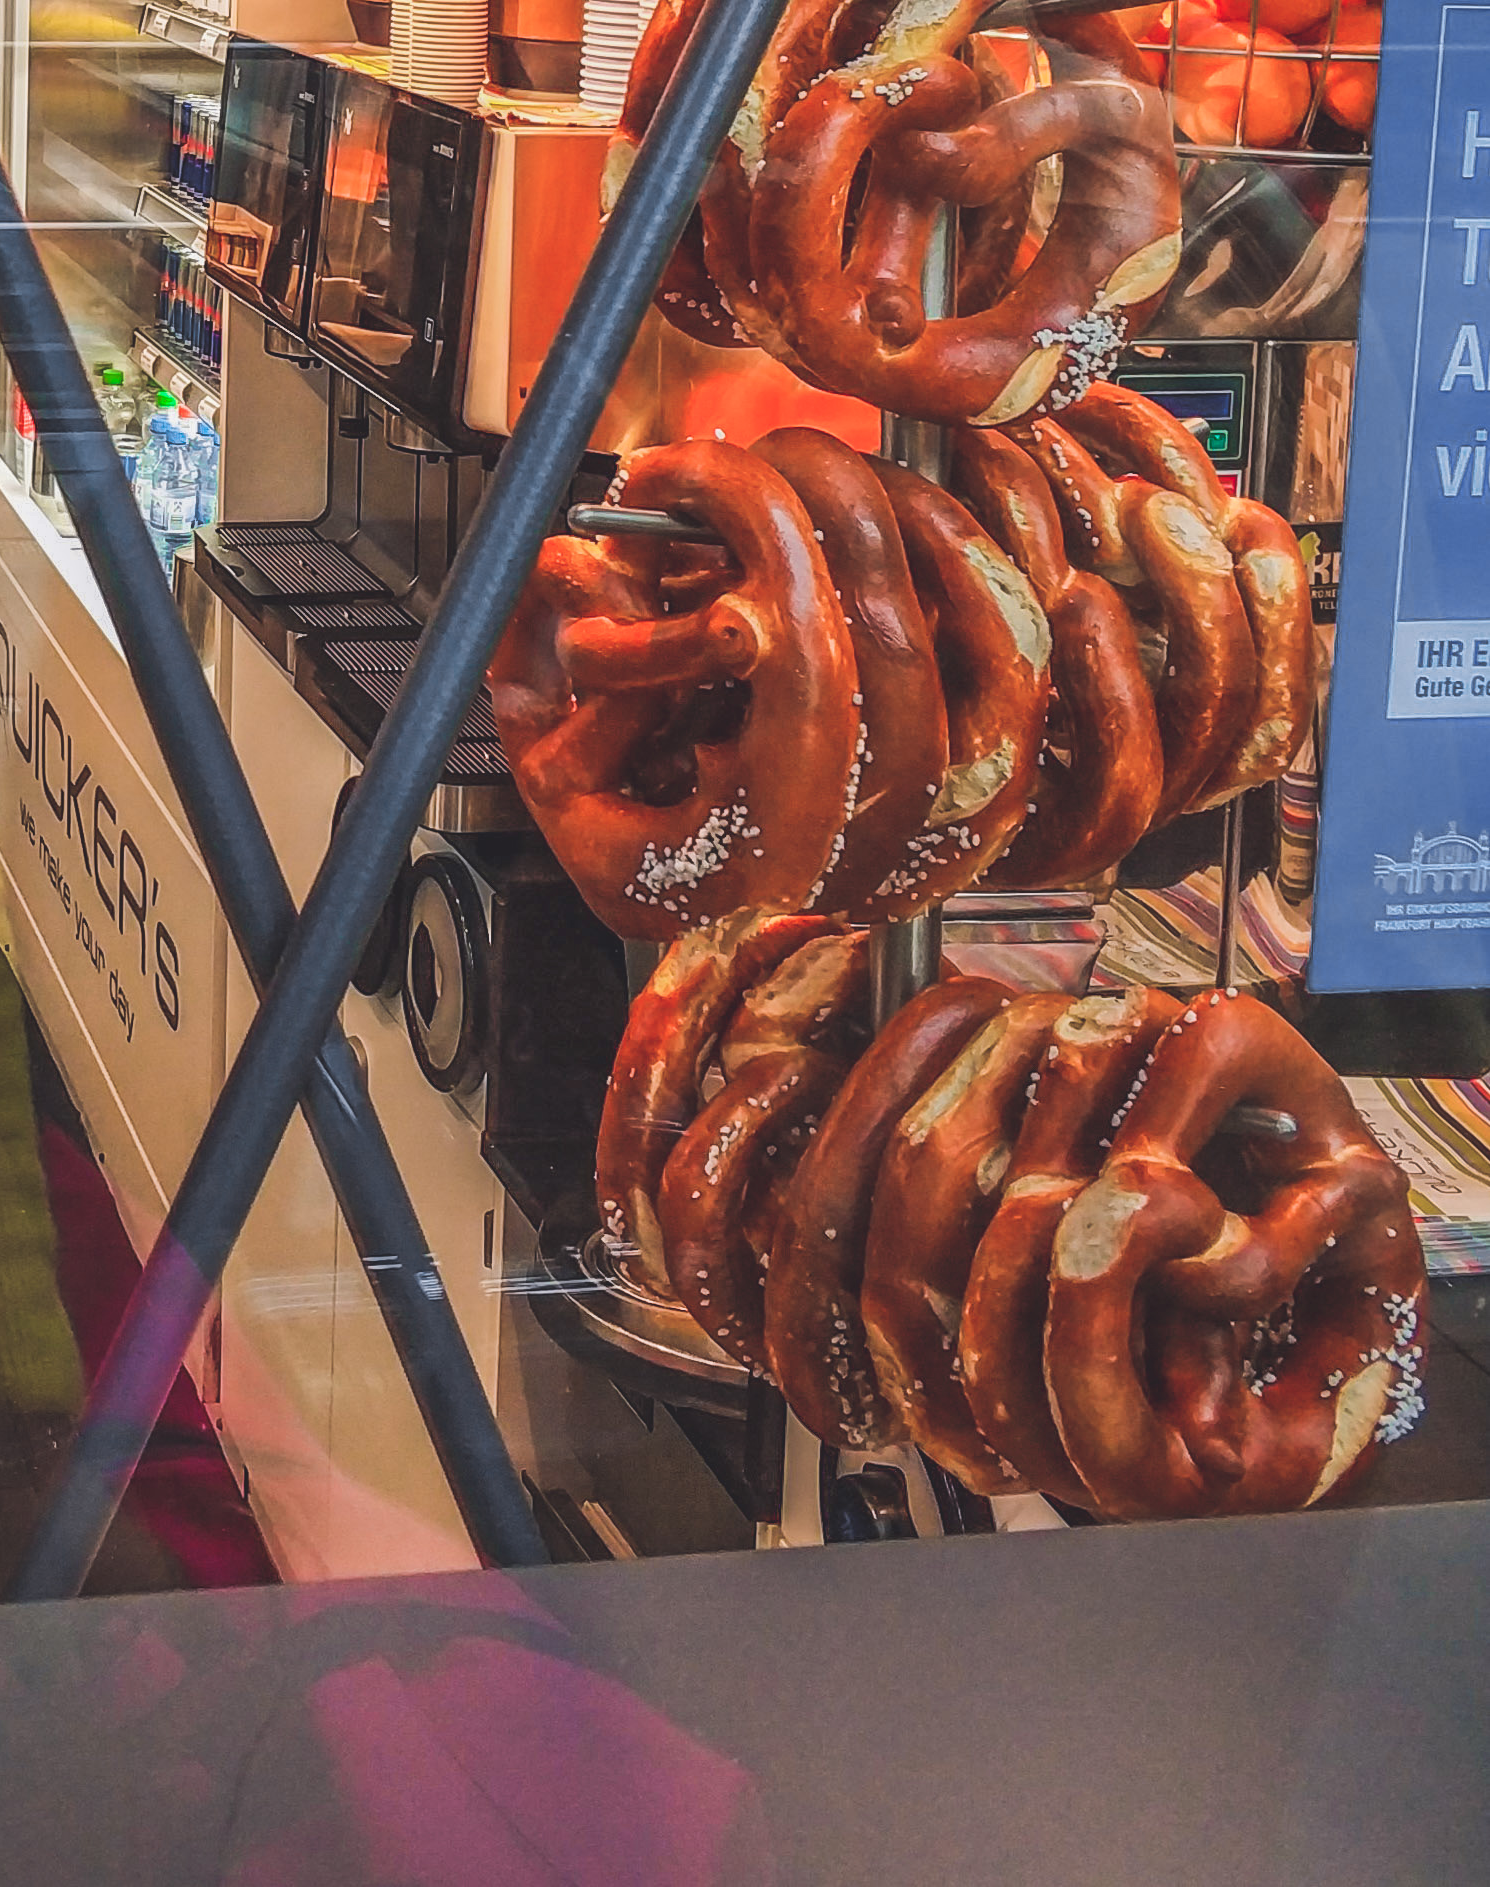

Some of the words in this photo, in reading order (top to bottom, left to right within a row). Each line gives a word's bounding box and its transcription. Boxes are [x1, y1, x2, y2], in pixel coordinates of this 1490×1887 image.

[1453, 217, 1490, 285] T
[1440, 324, 1490, 392] A
[1436, 429, 1490, 497] vi
[1415, 675, 1464, 698] Gute
[1417, 639, 1465, 669] IHR
[1471, 638, 1490, 668] E
[20, 796, 37, 838] we
[38, 831, 73, 915] make
[73, 896, 107, 976] your
[108, 968, 136, 1044] day
